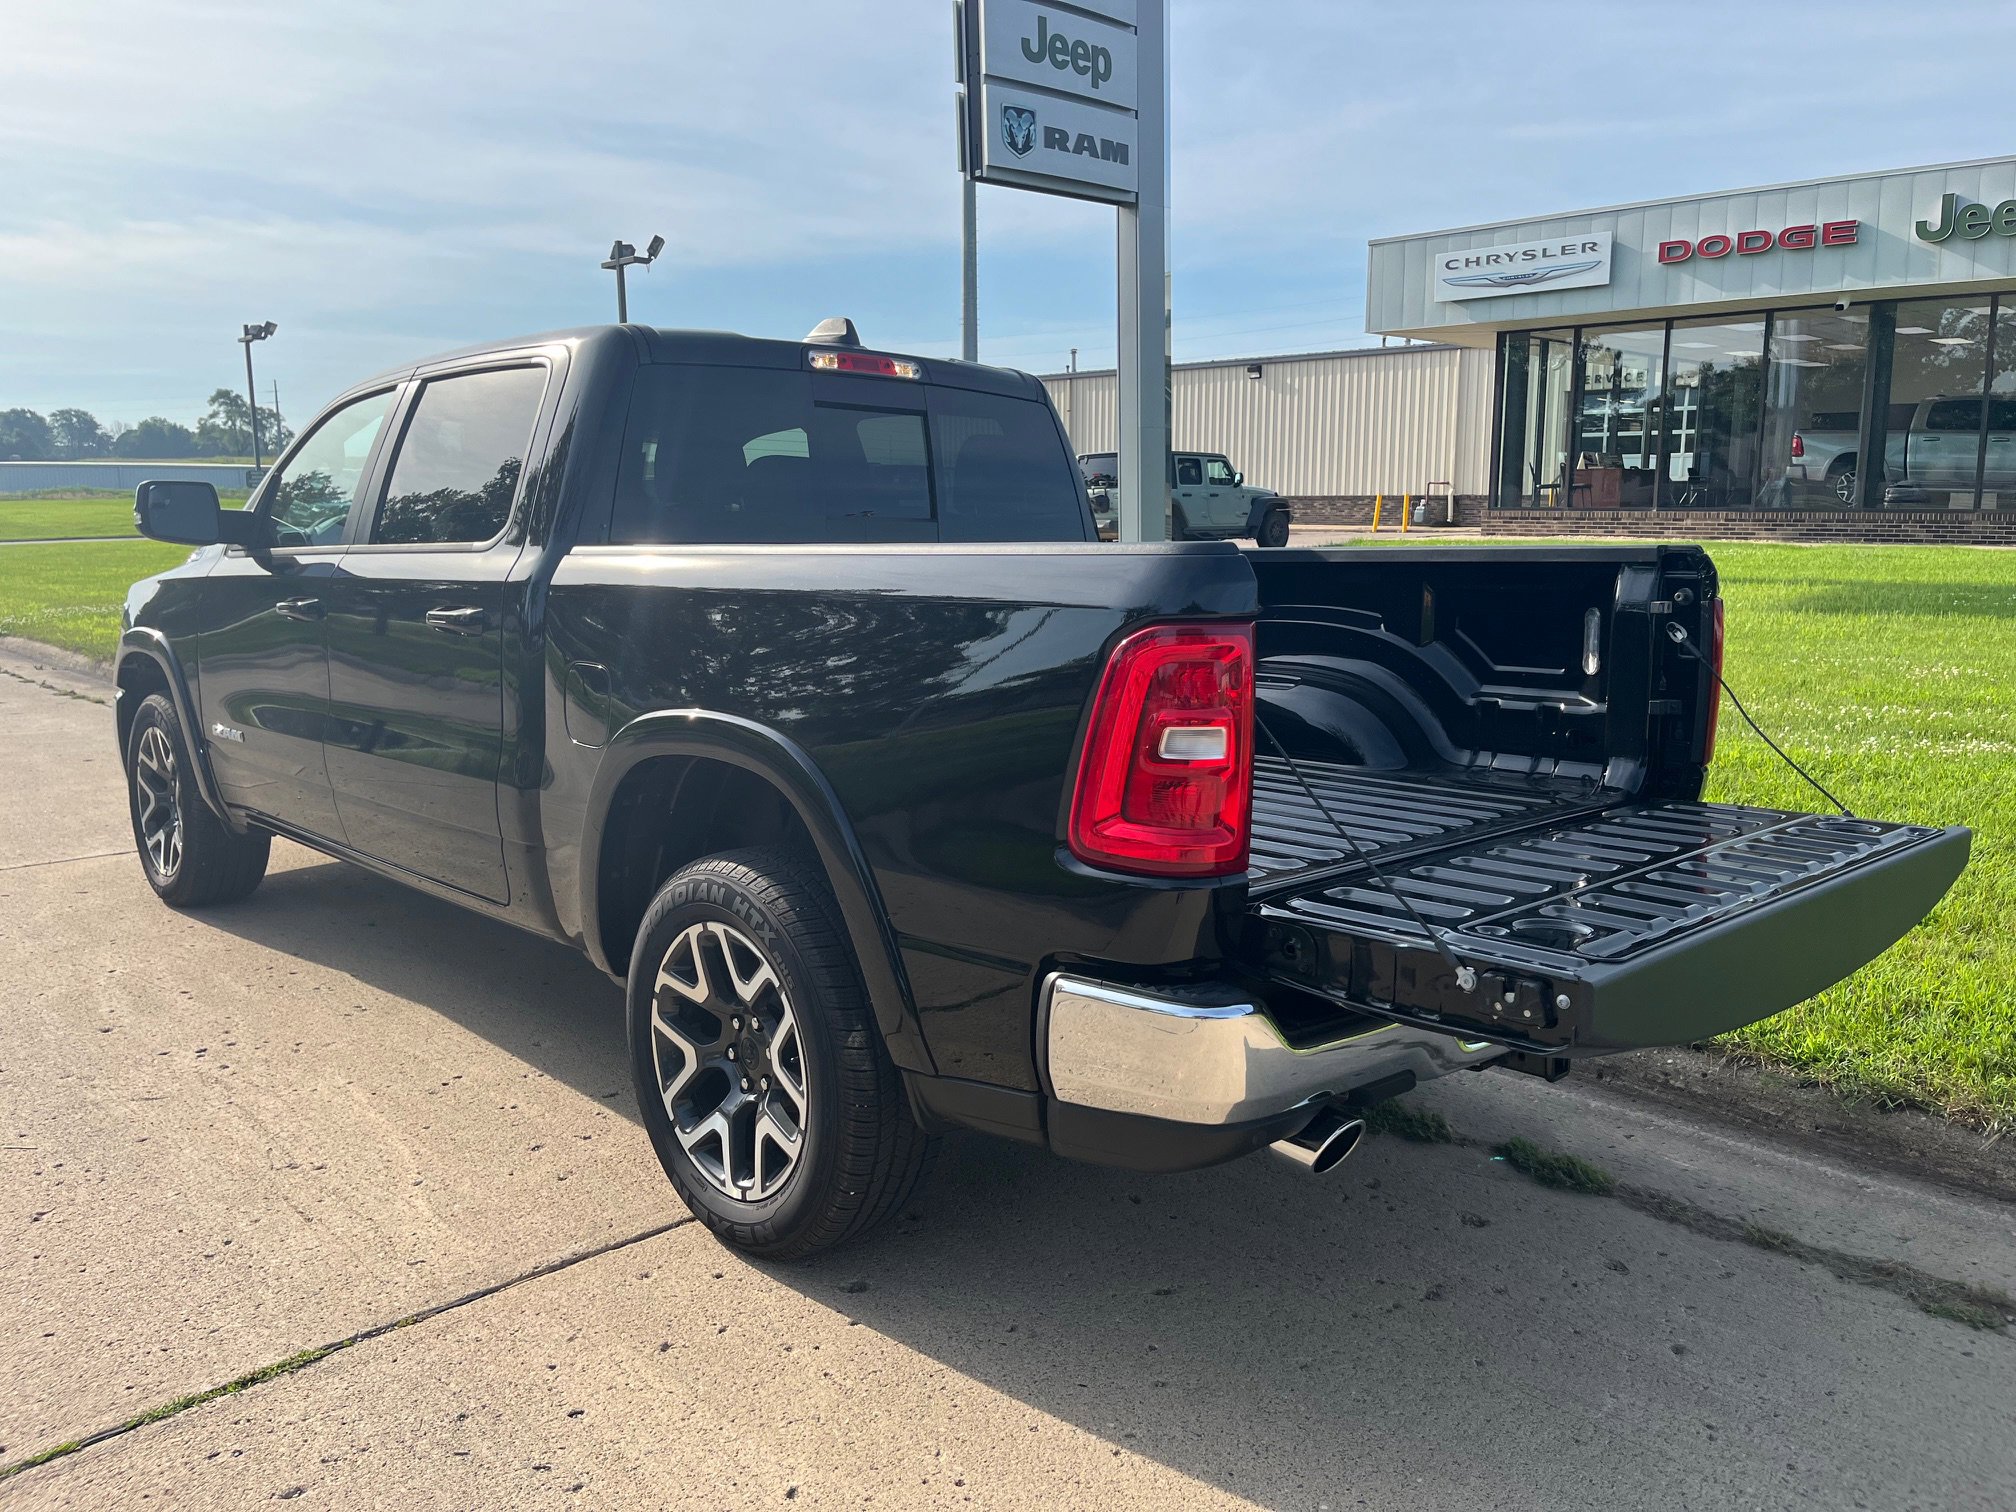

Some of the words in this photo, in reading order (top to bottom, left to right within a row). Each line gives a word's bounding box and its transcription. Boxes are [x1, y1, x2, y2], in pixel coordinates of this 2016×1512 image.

[1021, 15, 1112, 89] Jeep
[1043, 125, 1129, 166] RAM
[1445, 241, 1599, 271] CHRYSLER
[1657, 219, 1860, 264] DODGE
[731, 895, 779, 947] HTX
